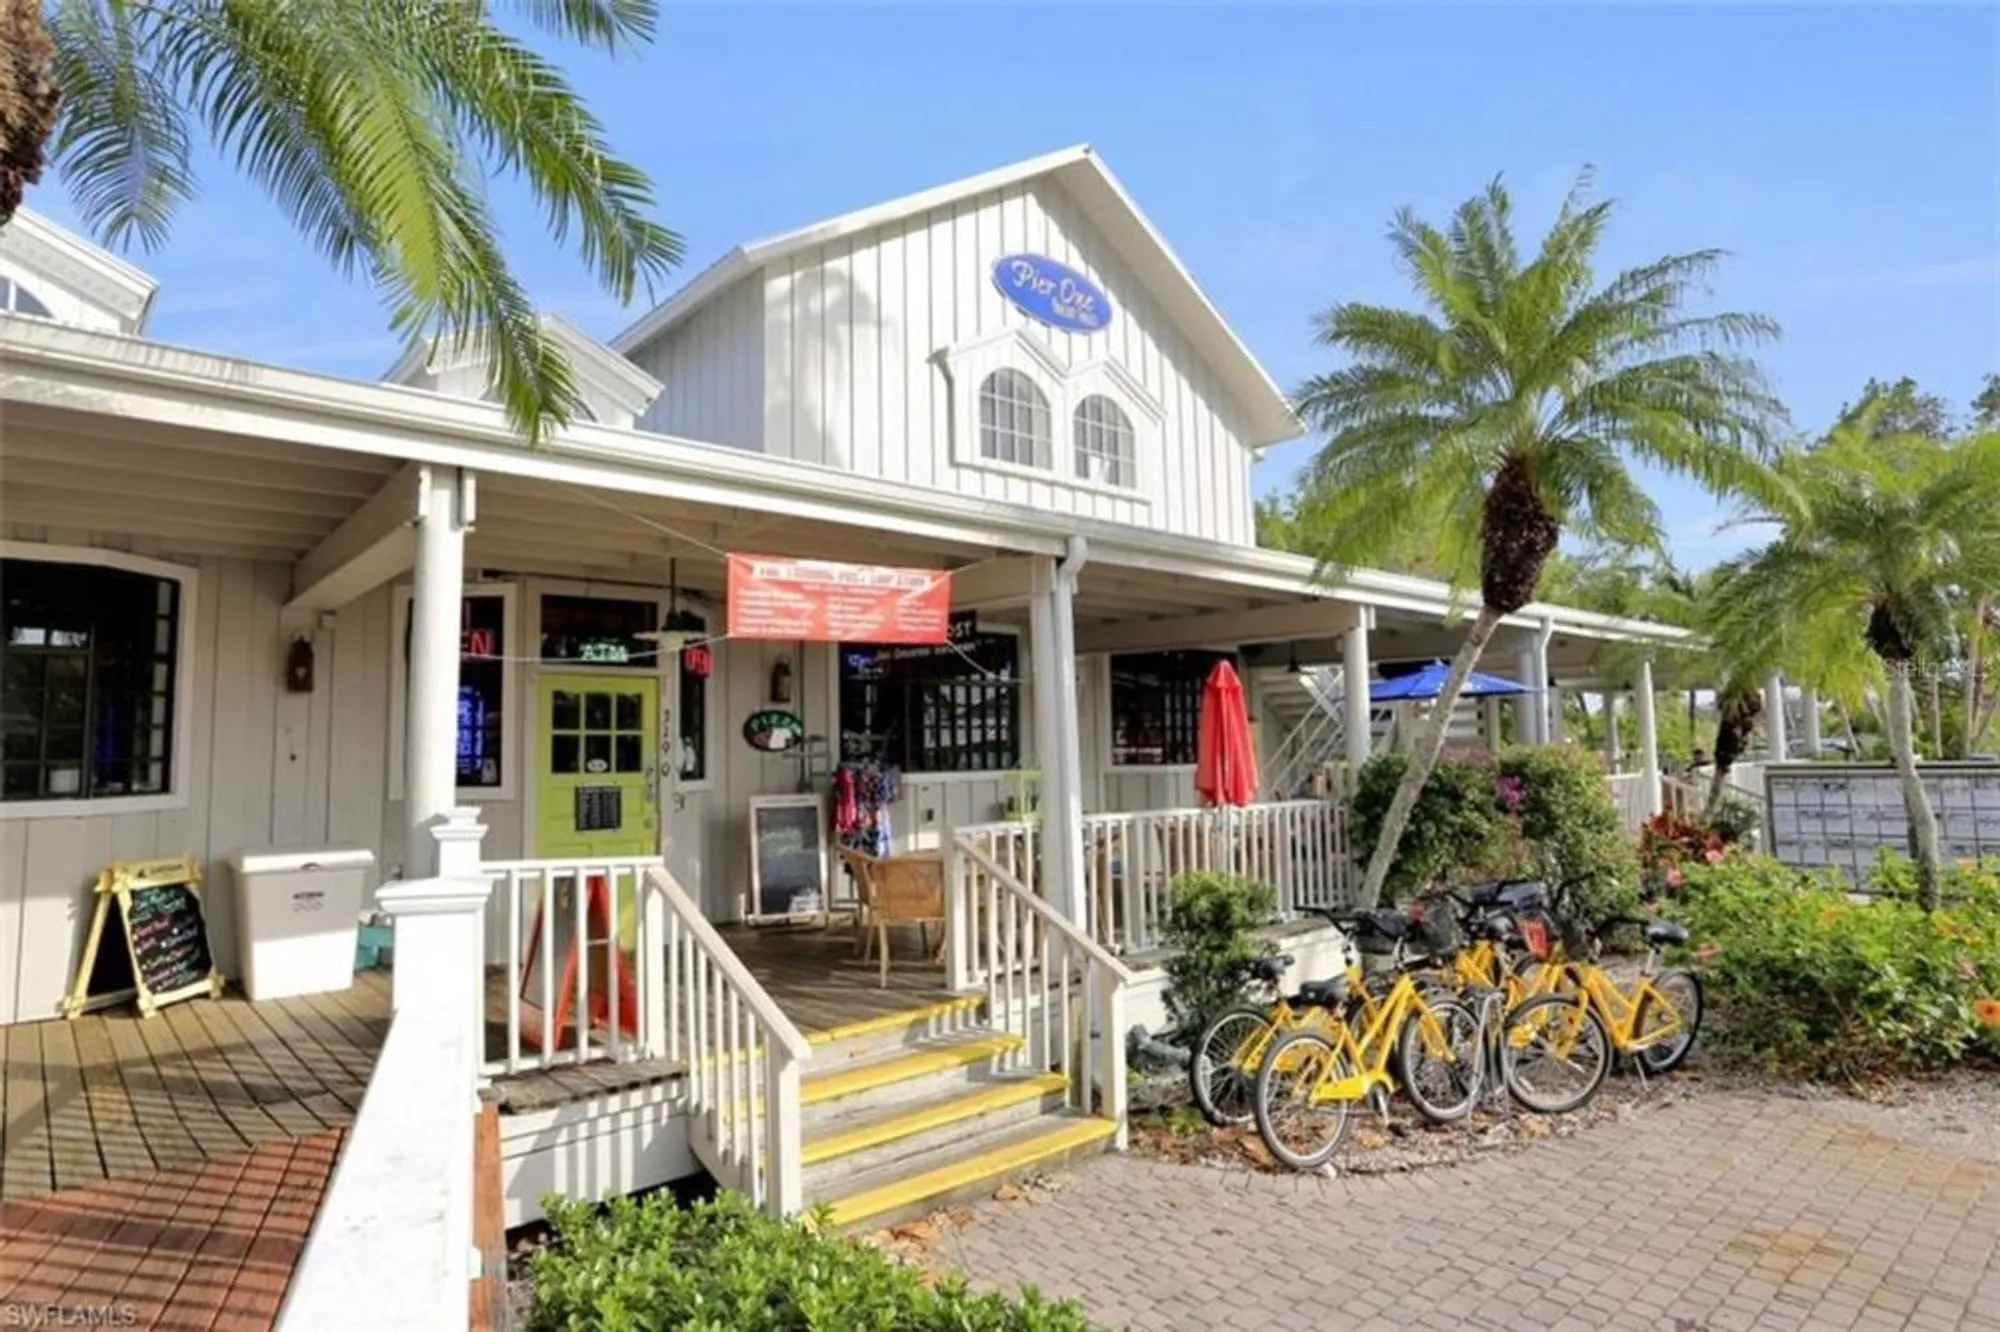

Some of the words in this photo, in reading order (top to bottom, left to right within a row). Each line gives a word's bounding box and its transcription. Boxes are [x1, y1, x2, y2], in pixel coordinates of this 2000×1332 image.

[1011, 260, 1056, 296] Pier
[1060, 278, 1097, 311] One
[751, 713, 802, 736] PIZZA
